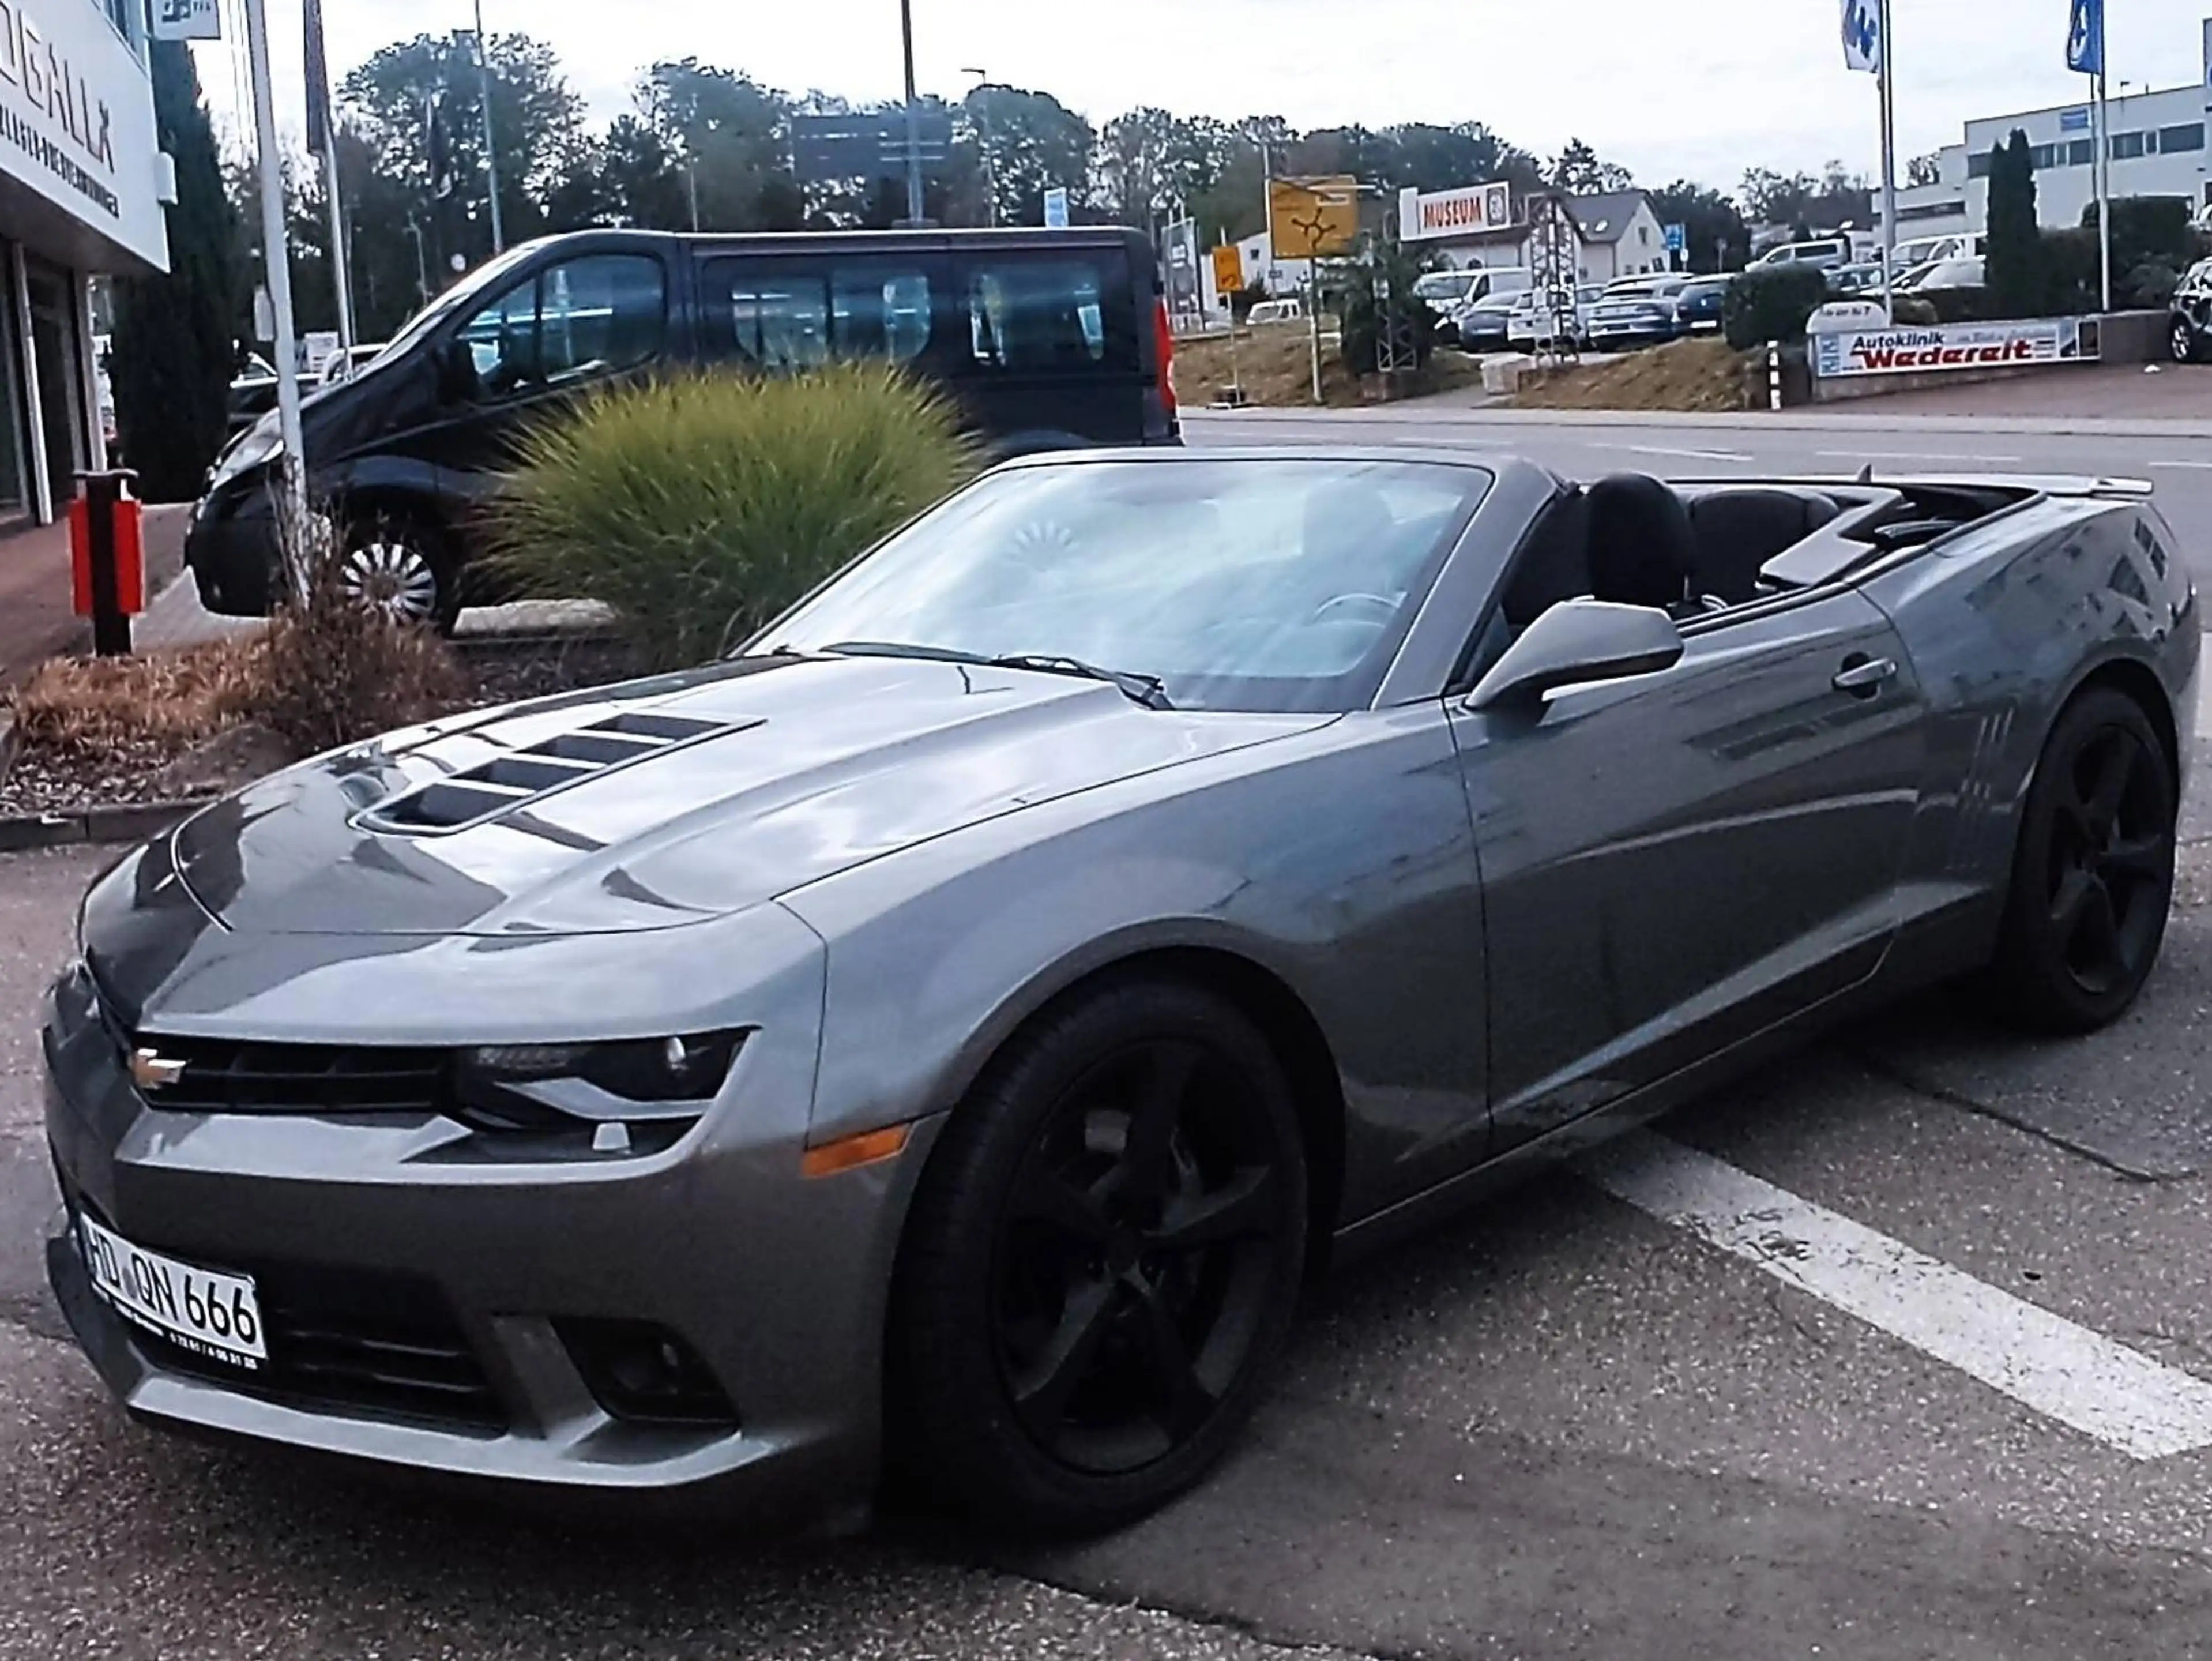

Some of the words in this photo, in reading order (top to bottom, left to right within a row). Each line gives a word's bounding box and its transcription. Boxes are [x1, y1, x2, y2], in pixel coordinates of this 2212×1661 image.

[1423, 195, 1482, 227] MUSEUM
[1850, 340, 2032, 369] Wedereit
[1853, 331, 1945, 348] Autoklinik
[131, 1253, 179, 1321] QN
[185, 1274, 257, 1344] 666
